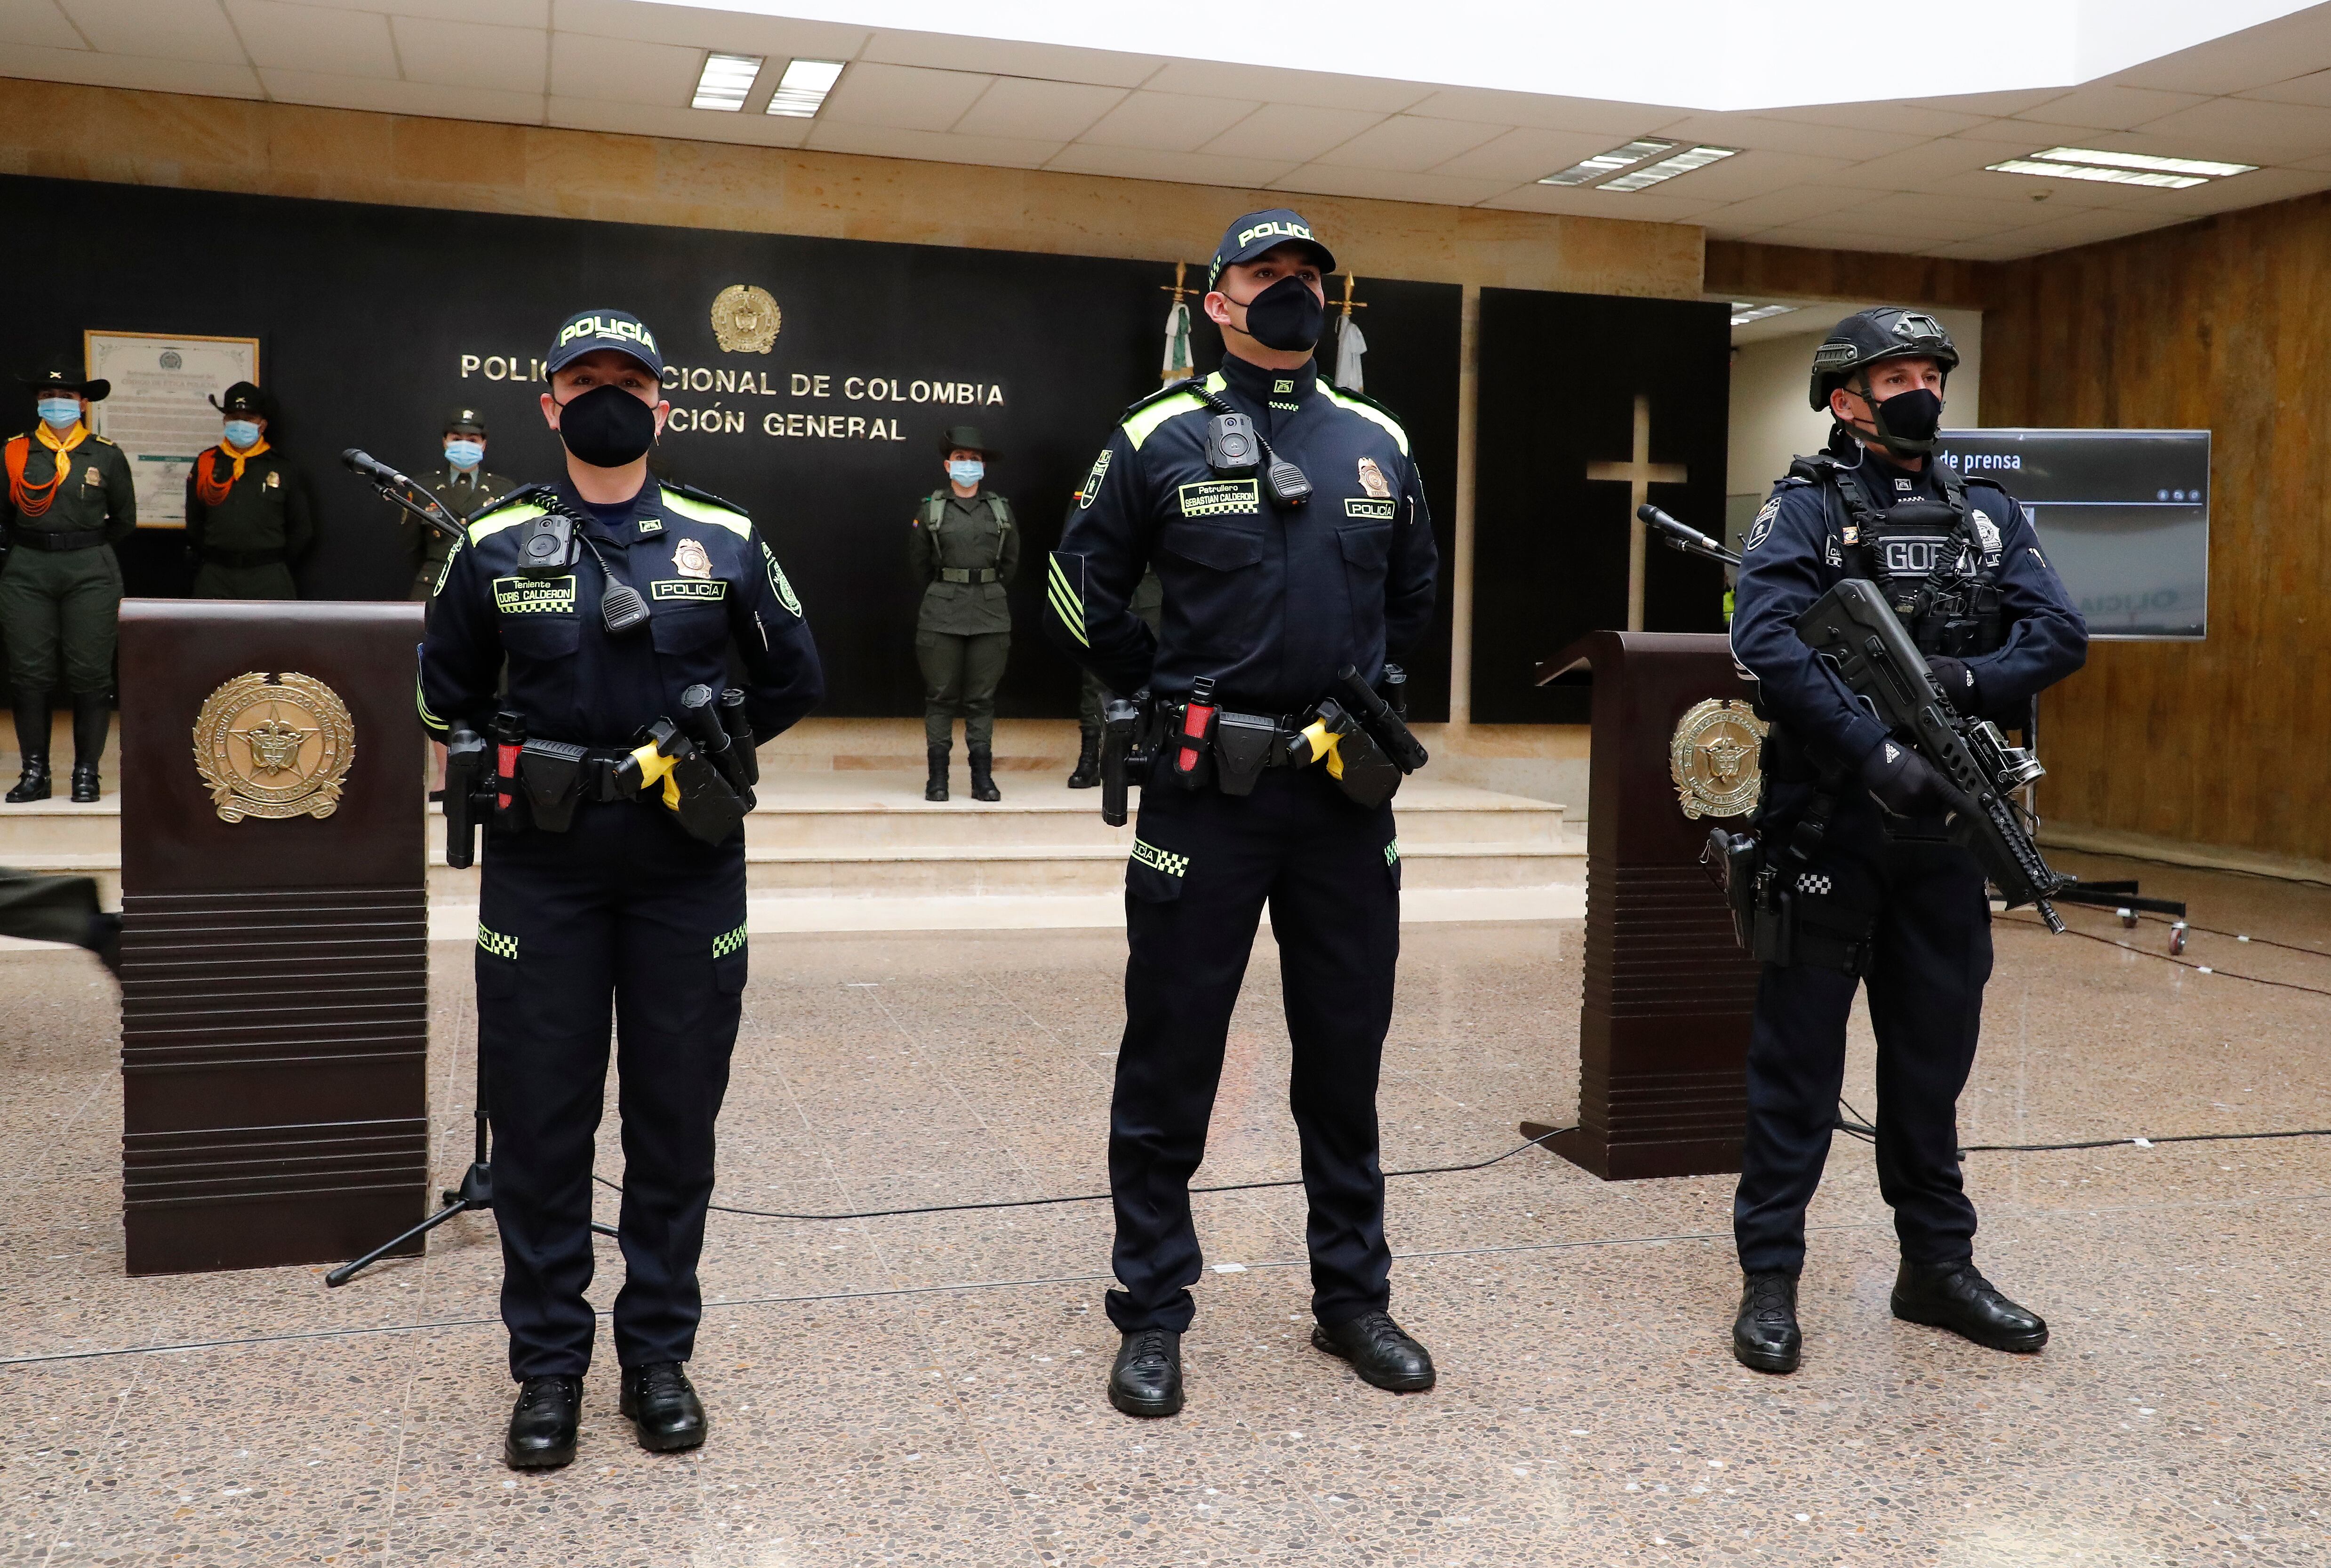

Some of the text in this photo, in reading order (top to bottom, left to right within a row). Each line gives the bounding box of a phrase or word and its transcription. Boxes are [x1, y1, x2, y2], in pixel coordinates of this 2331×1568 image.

[461, 354, 1004, 406] POLI CIONAL DE COLOMBIA
[763, 412, 906, 441] GENERAL
[1939, 449, 2021, 474] de prensa
[1198, 484, 1238, 495] Patrullero
[1185, 492, 1254, 508] SEBASTIAN CALDERON
[1352, 504, 1391, 516] POLICÍA
[513, 580, 551, 589] Teniente
[660, 584, 719, 596] POLICÍA
[498, 589, 570, 603] DORIS CALDERON
